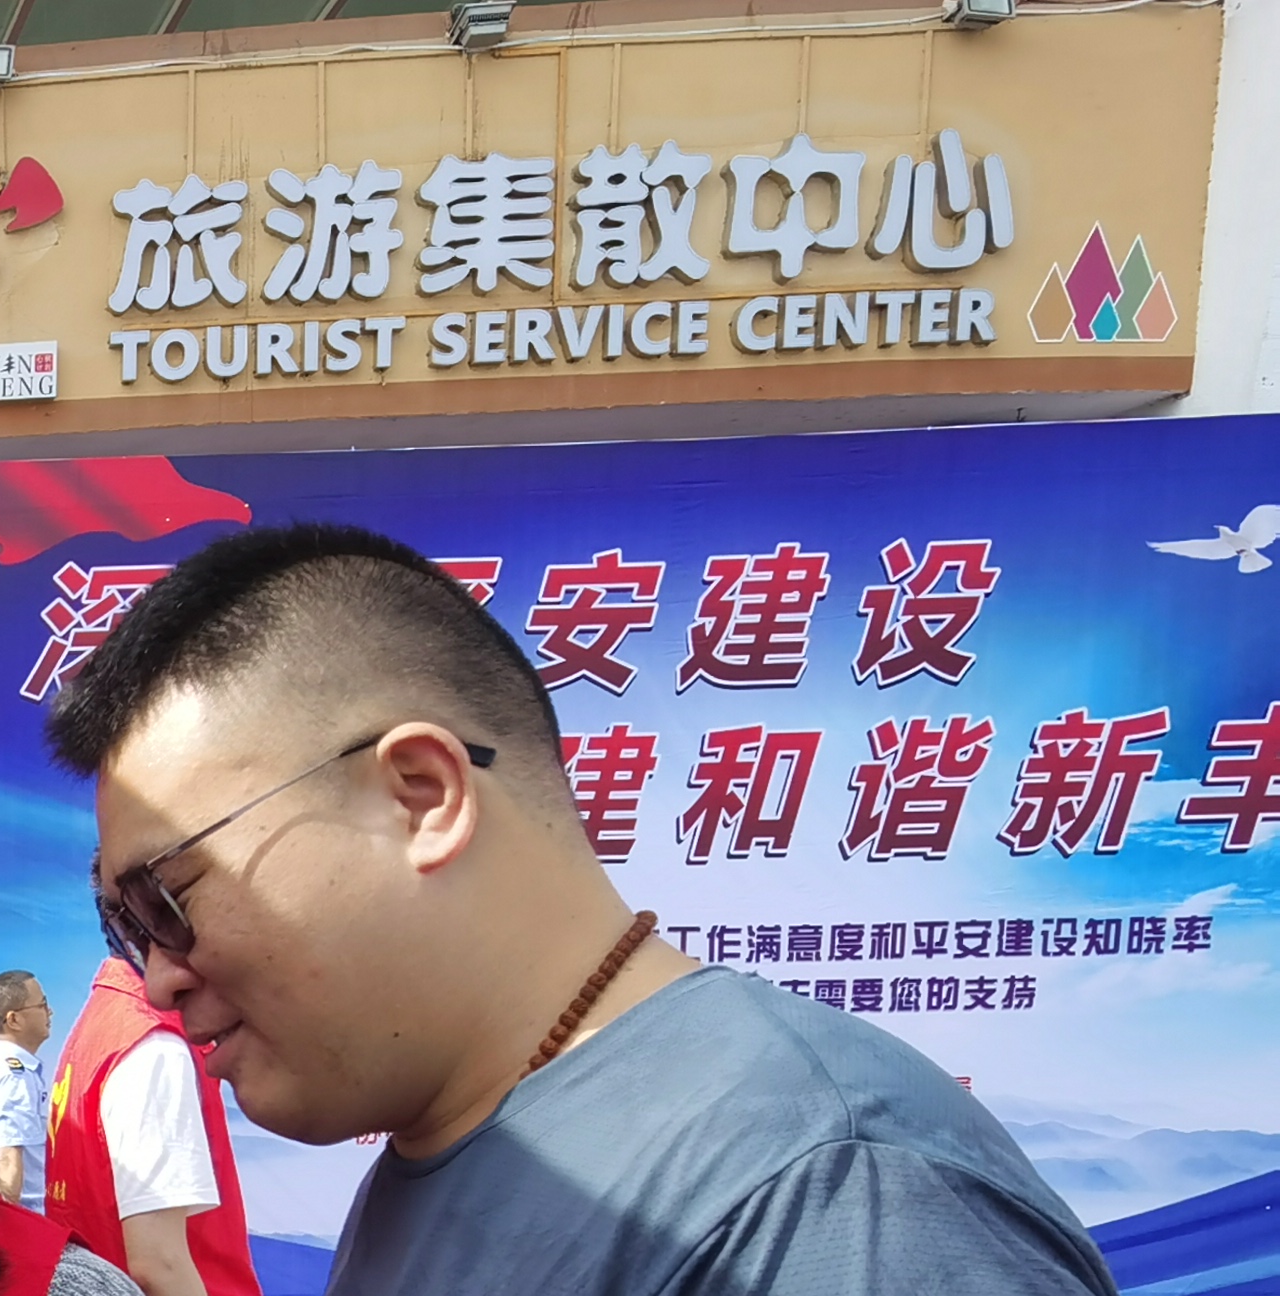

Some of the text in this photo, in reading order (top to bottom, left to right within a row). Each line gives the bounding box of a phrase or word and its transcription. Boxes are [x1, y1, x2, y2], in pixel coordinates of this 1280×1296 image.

[107, 126, 1016, 316] 旅游集散中心
[107, 286, 999, 386] TOURIST SERVICE CENTER
[651, 914, 1216, 965] 工作满意度和平安建设知晓率
[767, 973, 1038, 1015] 需要您的支持
